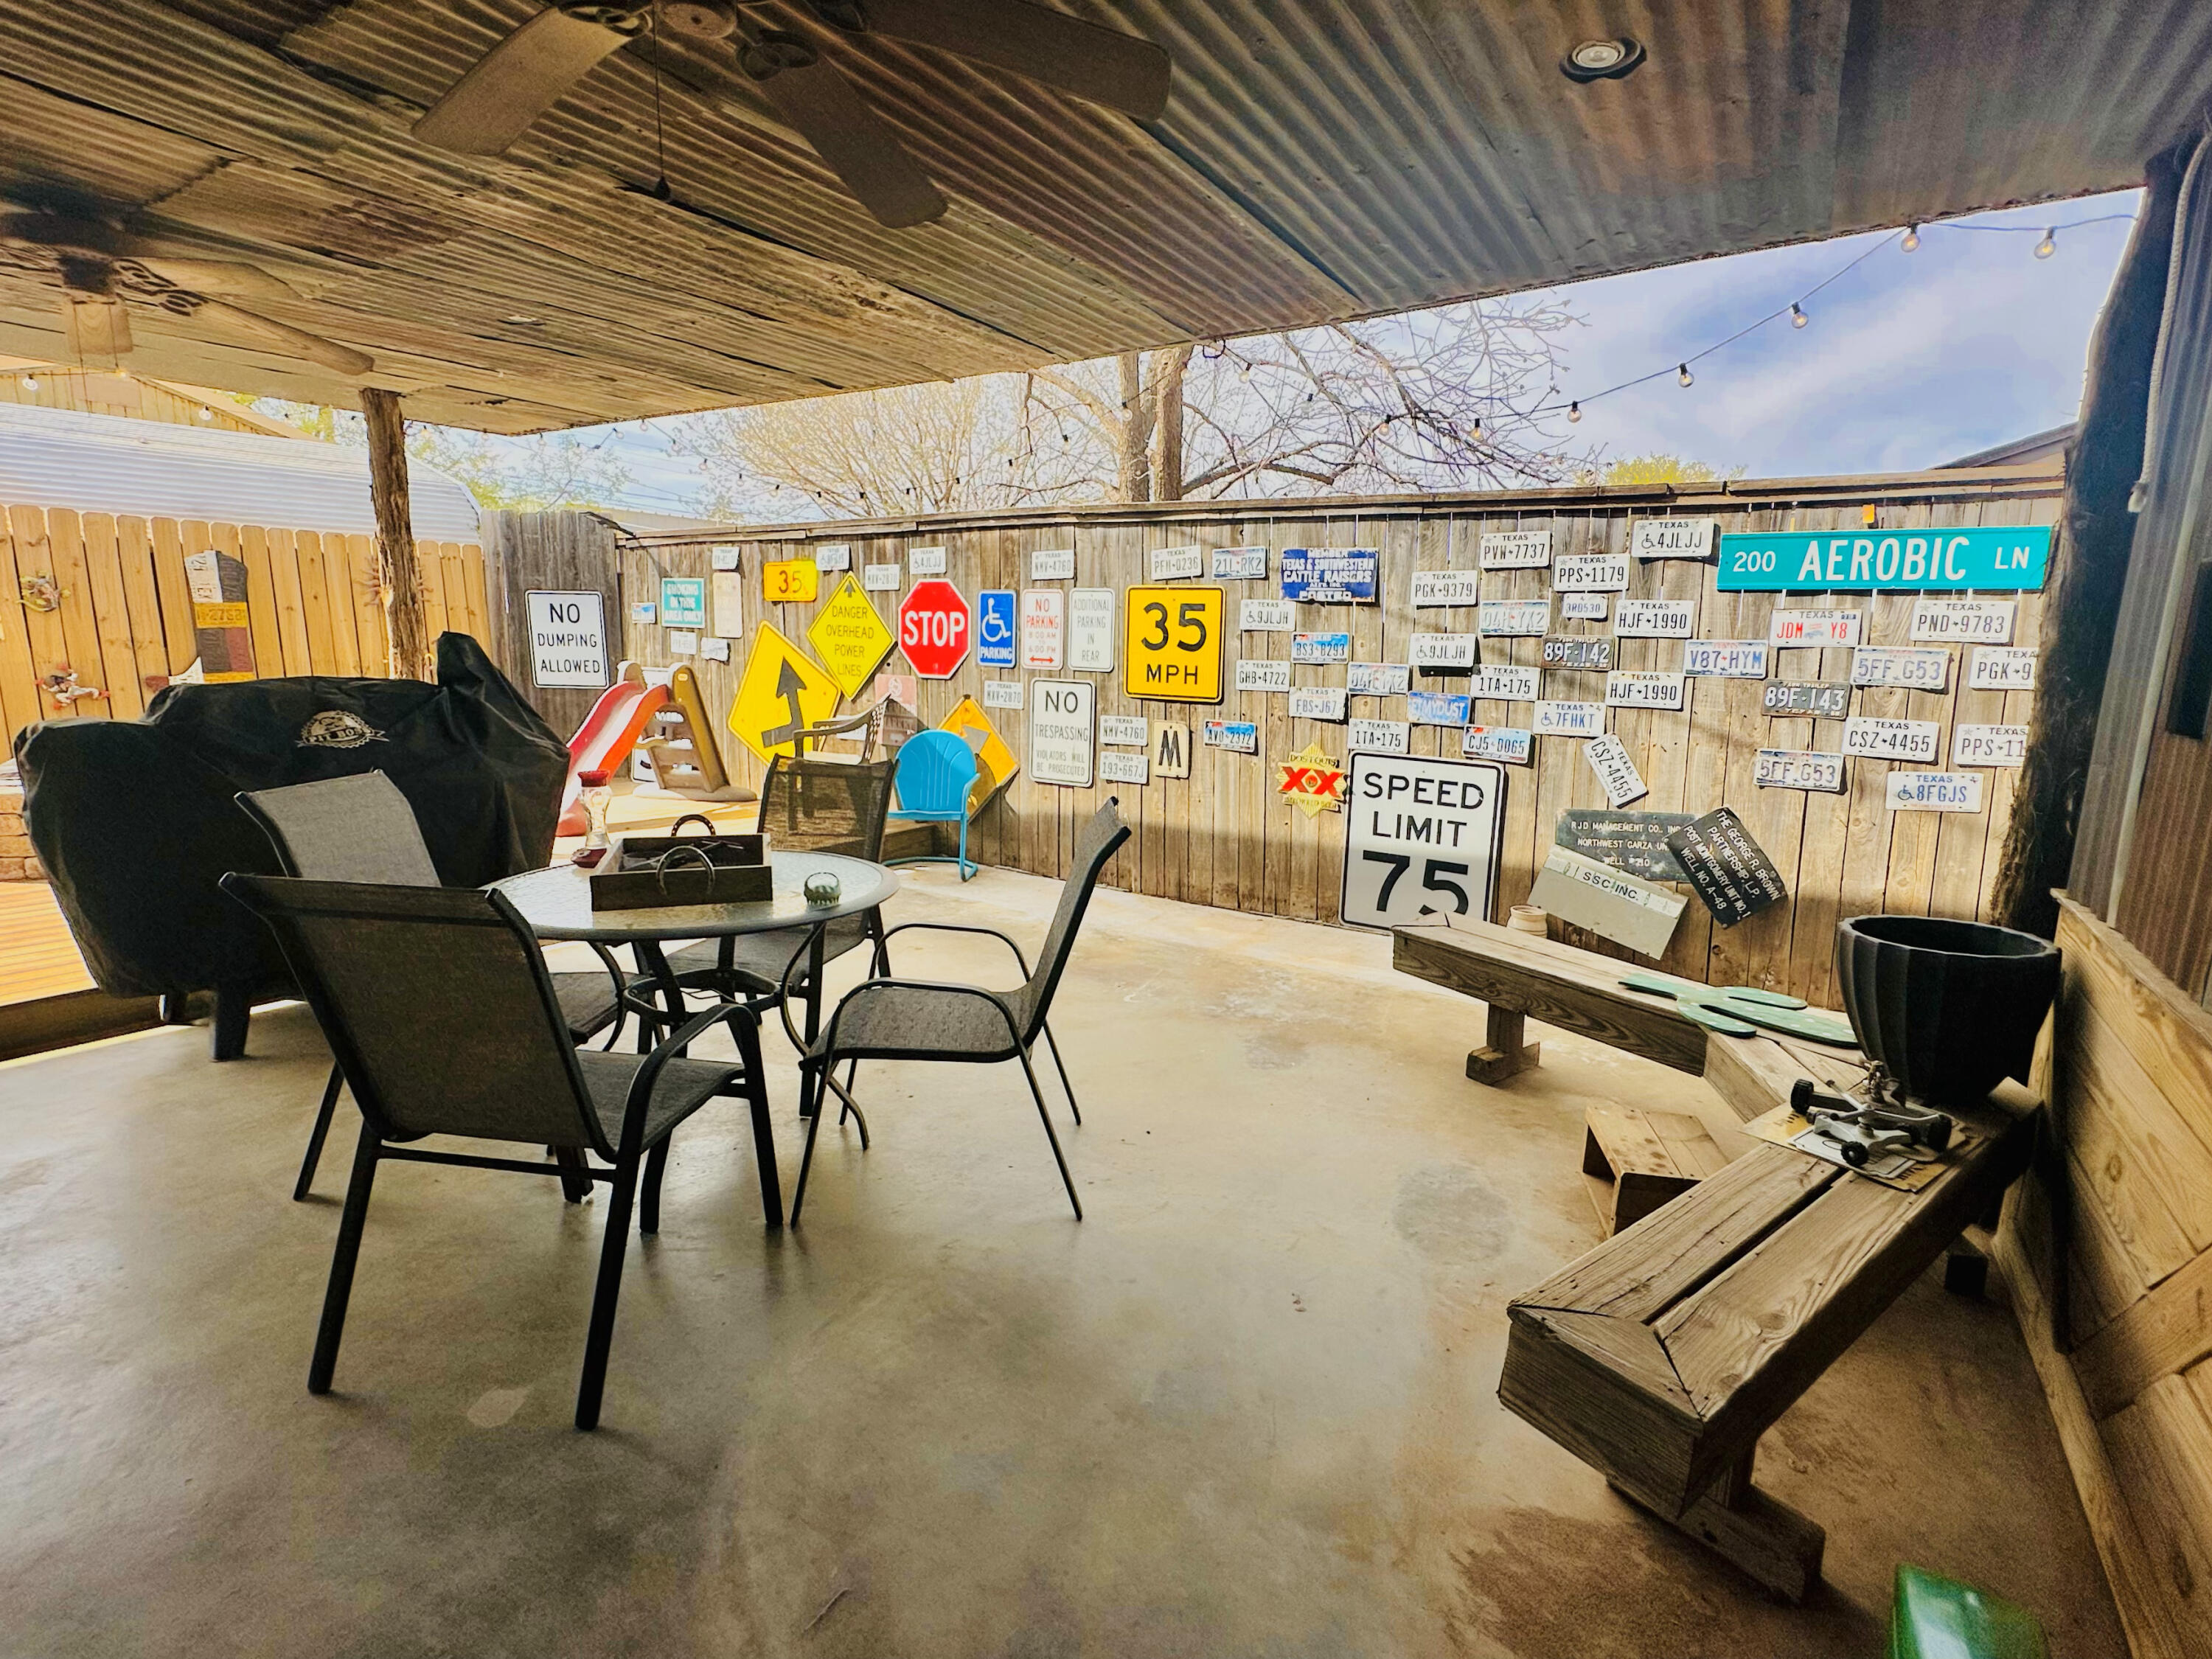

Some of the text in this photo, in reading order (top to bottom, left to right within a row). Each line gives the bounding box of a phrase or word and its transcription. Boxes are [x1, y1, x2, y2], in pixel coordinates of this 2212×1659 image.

[1659, 521, 1689, 529] TEXAS
[1281, 558, 1305, 570] TEXAS
[1733, 536, 2030, 581] 200 AEROBIC LN
[778, 569, 803, 594] 35
[1283, 571, 1321, 583] CATTLE
[1035, 598, 1050, 612] NO
[1074, 598, 1110, 611] ADDITIONAL
[1946, 603, 1983, 611] TEXAS
[549, 603, 580, 623] NO
[832, 605, 868, 619] DANGER
[1799, 611, 1834, 619] TEXAS
[903, 611, 967, 647] STOP
[1026, 615, 1059, 630] PARKING
[1077, 616, 1106, 629] PARKING
[1141, 602, 1207, 653] 35
[826, 625, 874, 639] OVERHEAD
[1777, 622, 1848, 639] JDM Y8
[538, 633, 597, 647] DUMPING
[1087, 633, 1094, 645] IN
[834, 644, 865, 658] POWER
[980, 646, 1012, 661] PARKING
[1082, 650, 1099, 662] REAR
[540, 658, 600, 673] ALLOWED
[837, 664, 862, 678] LINES
[1146, 664, 1199, 685] MPH
[1045, 690, 1078, 713] NO
[1556, 703, 1584, 712] TEXAS
[1034, 723, 1088, 742] TRESPASSING
[1874, 721, 1910, 730] TEXAS
[1989, 727, 2026, 735] TEXAS
[1158, 730, 1181, 768] M
[1618, 751, 1634, 776] TEXAS
[1916, 775, 1953, 783] TEXAS
[1363, 772, 1484, 810] SPEED
[1916, 785, 1967, 802] 8FGJS
[1373, 811, 1467, 847] LIMIT
[1593, 821, 1644, 833] MANAGEMENT
[1578, 838, 1624, 848] NORTHWEST
[1627, 841, 1652, 850] GARZA
[1604, 856, 1624, 866] WELL
[1716, 811, 1733, 830] THE
[1727, 828, 1755, 861] GEORGE
[1755, 869, 1781, 901] BROWN
[1683, 825, 1702, 844] POST
[1695, 842, 1731, 886] MONTGOMERY
[1724, 885, 1741, 901] UNIT
[1734, 900, 1747, 914] NO.
[1363, 849, 1469, 916] 75
[1680, 847, 1727, 910] WELL NO. A-48
[1582, 872, 1638, 901] SSC INC.
